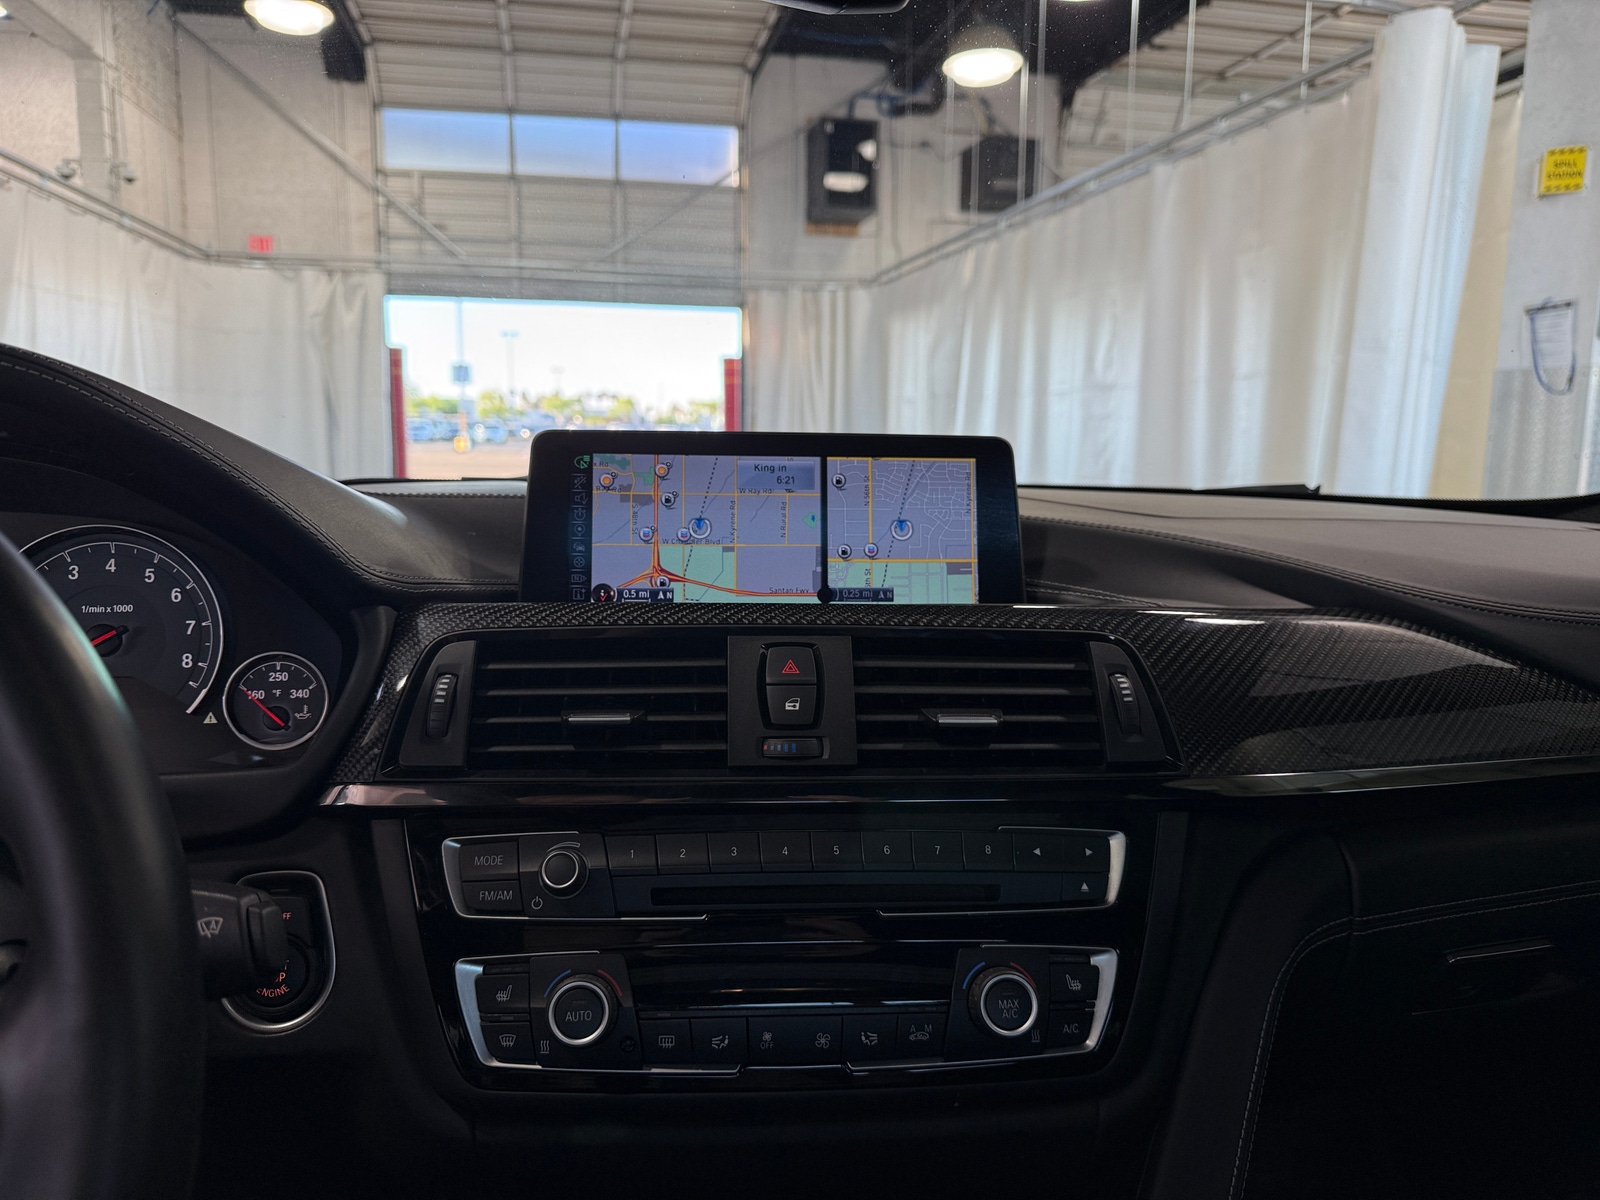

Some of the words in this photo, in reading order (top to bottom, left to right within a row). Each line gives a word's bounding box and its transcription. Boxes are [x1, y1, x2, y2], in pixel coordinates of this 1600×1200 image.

[754, 464, 775, 473] King
[778, 464, 787, 472] in
[776, 476, 795, 485] 6:21
[749, 488, 760, 496] Ray
[730, 500, 736, 510] Rd
[780, 501, 787, 511] Rd
[105, 558, 117, 572] 4
[67, 565, 79, 580] 3
[144, 568, 155, 583] 5
[170, 587, 182, 602] 6
[623, 589, 636, 598] 0.5
[638, 589, 650, 598] mi
[666, 591, 673, 599] N
[795, 587, 809, 595] Fwy
[842, 589, 860, 598] 0.25
[862, 589, 873, 598] mi
[886, 591, 893, 599] N
[81, 605, 105, 614] 1/min
[113, 604, 133, 613] 1000
[185, 620, 196, 635] 7
[181, 653, 193, 668] 8
[268, 671, 289, 682] 250
[289, 689, 310, 699] 340
[629, 848, 635, 859] 1
[679, 848, 686, 858] 2
[730, 846, 738, 857] 3
[781, 845, 789, 856] 4
[832, 845, 840, 855] 5
[883, 844, 891, 855] 6
[934, 844, 941, 855] 7
[984, 844, 992, 855] 8
[474, 854, 504, 866] MODE
[478, 889, 513, 902] FM/AM
[998, 999, 1019, 1009] MAX
[565, 1010, 593, 1022] AUTO
[1002, 1008, 1018, 1019] A/C
[909, 1024, 916, 1032] A
[924, 1024, 933, 1033] M
[1062, 1023, 1079, 1033] A/C
[760, 1041, 774, 1050] OFF
